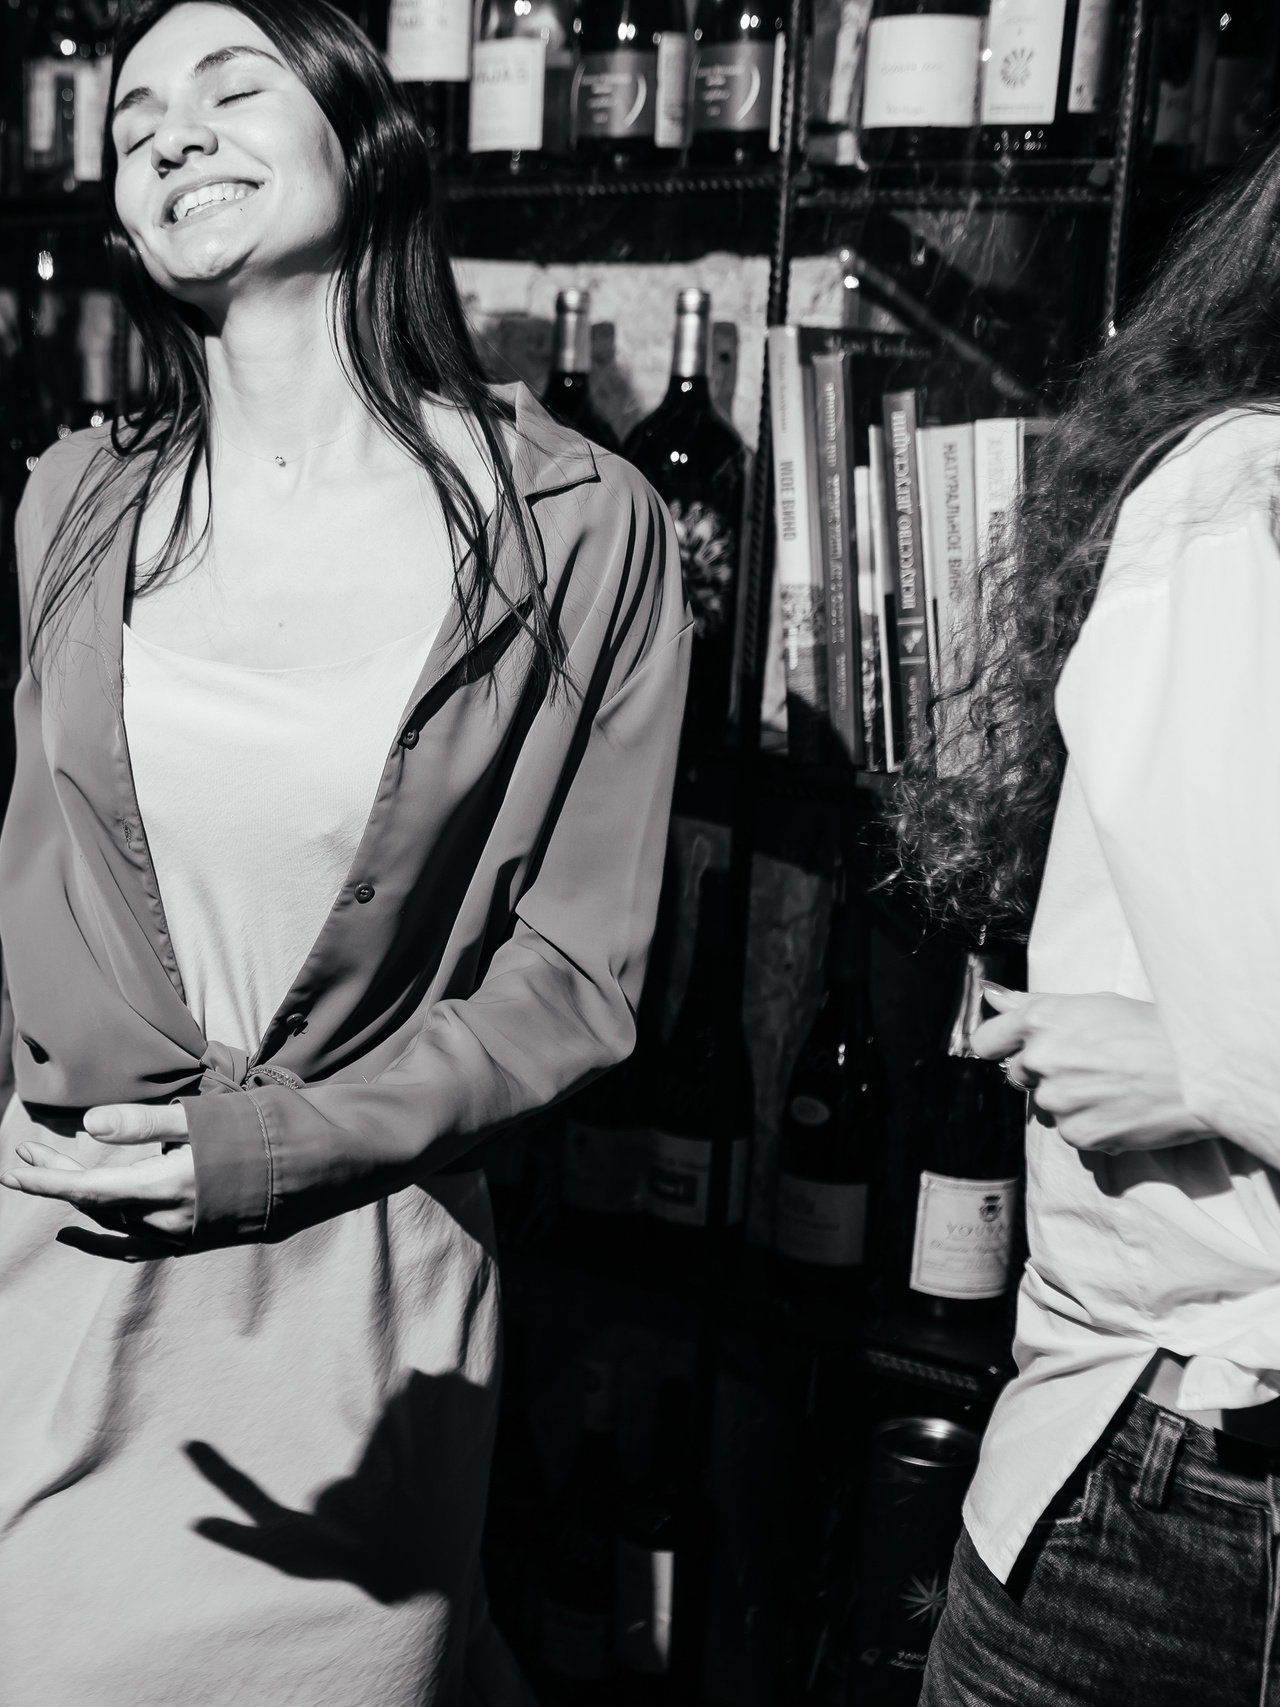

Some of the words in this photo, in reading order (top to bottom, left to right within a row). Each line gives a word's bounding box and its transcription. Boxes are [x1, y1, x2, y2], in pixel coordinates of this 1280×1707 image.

[780, 461, 795, 498] МОЕ
[891, 410, 913, 515] ДЕГУСТАЦИИ
[943, 441, 962, 551] НАТУРАЛЬНОЕ
[783, 500, 798, 541] ВИНО
[897, 514, 917, 610] ИСКУССТВО
[948, 559, 963, 600] ВИНО
